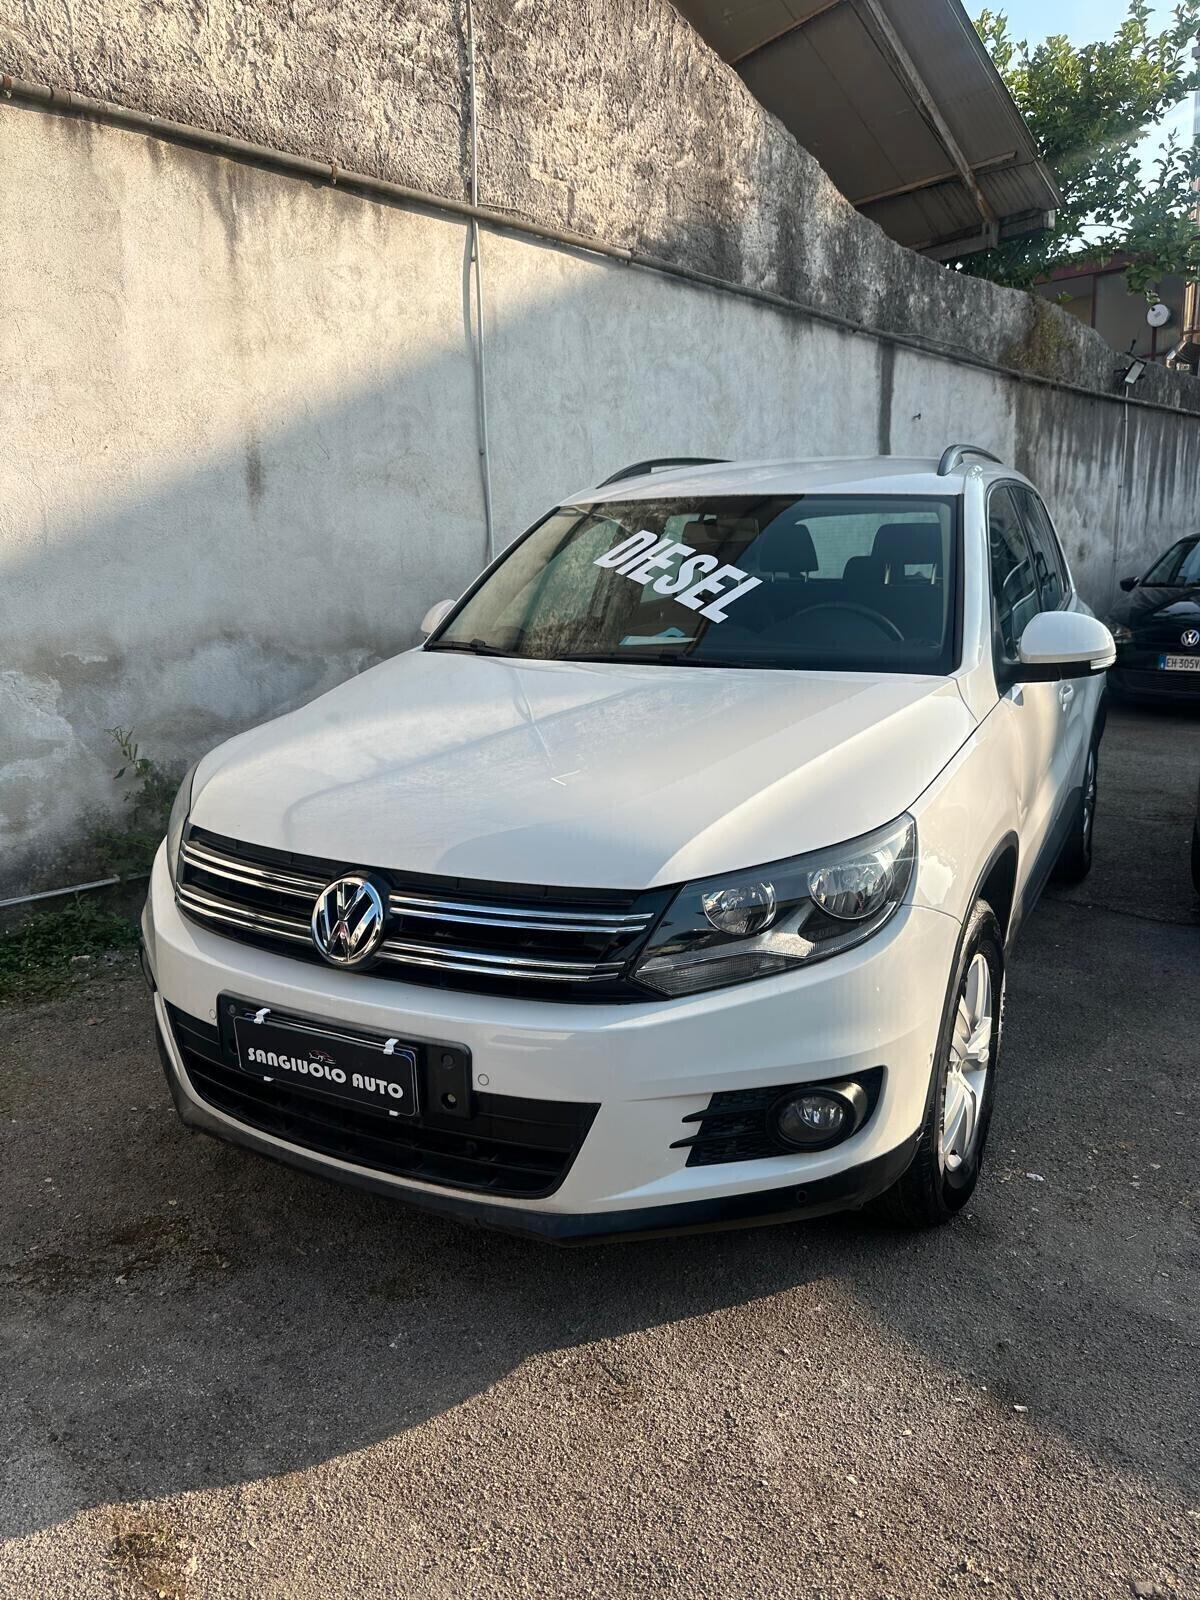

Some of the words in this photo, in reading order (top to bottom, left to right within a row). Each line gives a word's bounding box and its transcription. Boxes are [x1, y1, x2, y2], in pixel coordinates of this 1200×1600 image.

[593, 529, 763, 624] DIESEL
[1167, 657, 1177, 668] EH
[1179, 658, 1200, 669] 305V
[248, 1047, 347, 1084] SANGIUOLO
[352, 1073, 404, 1099] AUTO
